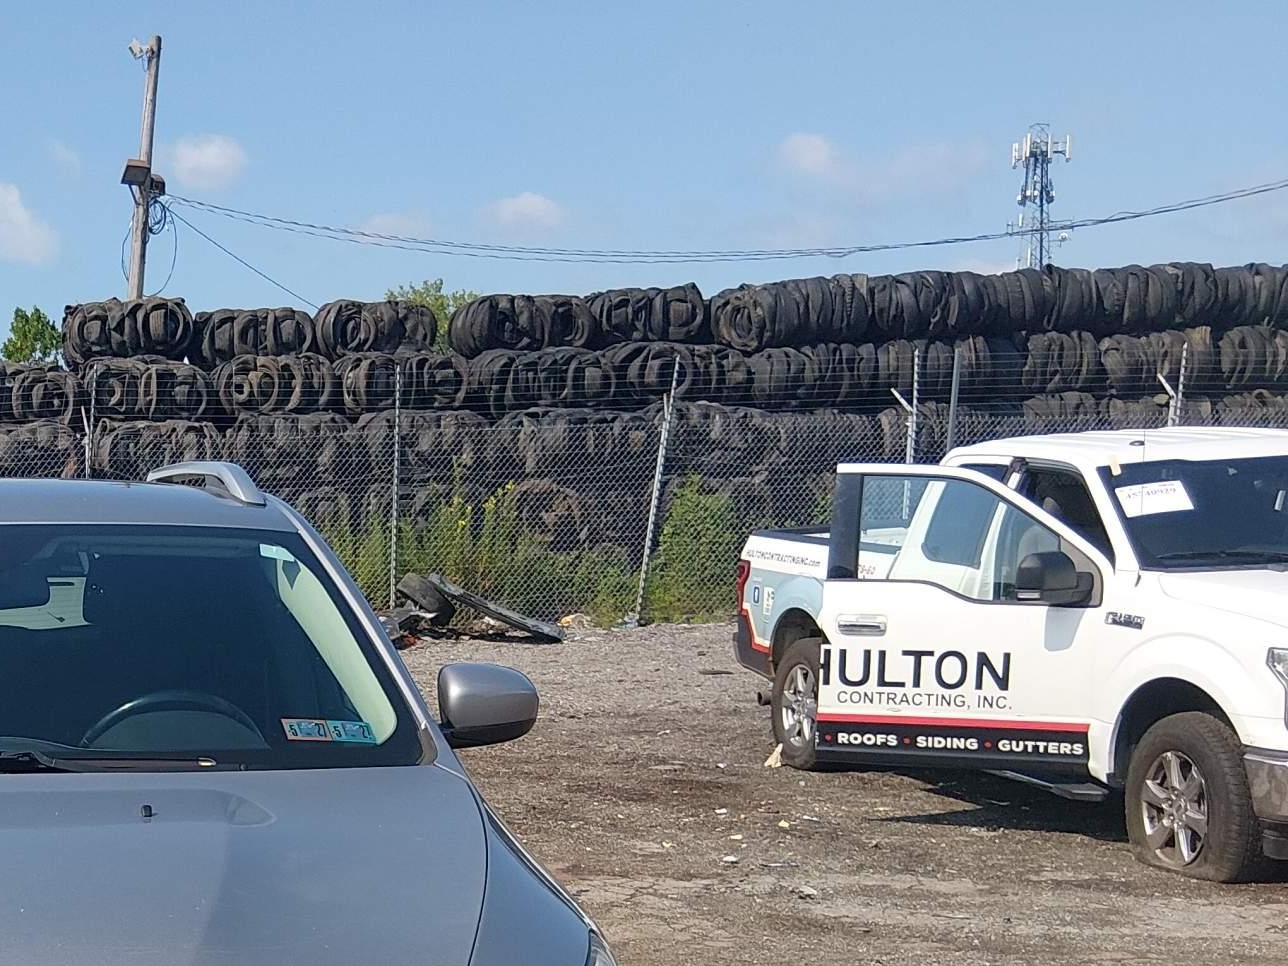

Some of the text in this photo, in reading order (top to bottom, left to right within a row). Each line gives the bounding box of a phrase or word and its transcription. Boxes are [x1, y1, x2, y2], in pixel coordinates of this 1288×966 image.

[837, 690, 1013, 710] CONTRACTING, INC.
[836, 732, 899, 746] ROOFS
[915, 735, 979, 750] SIDING
[997, 740, 1085, 756] GUTTERS
